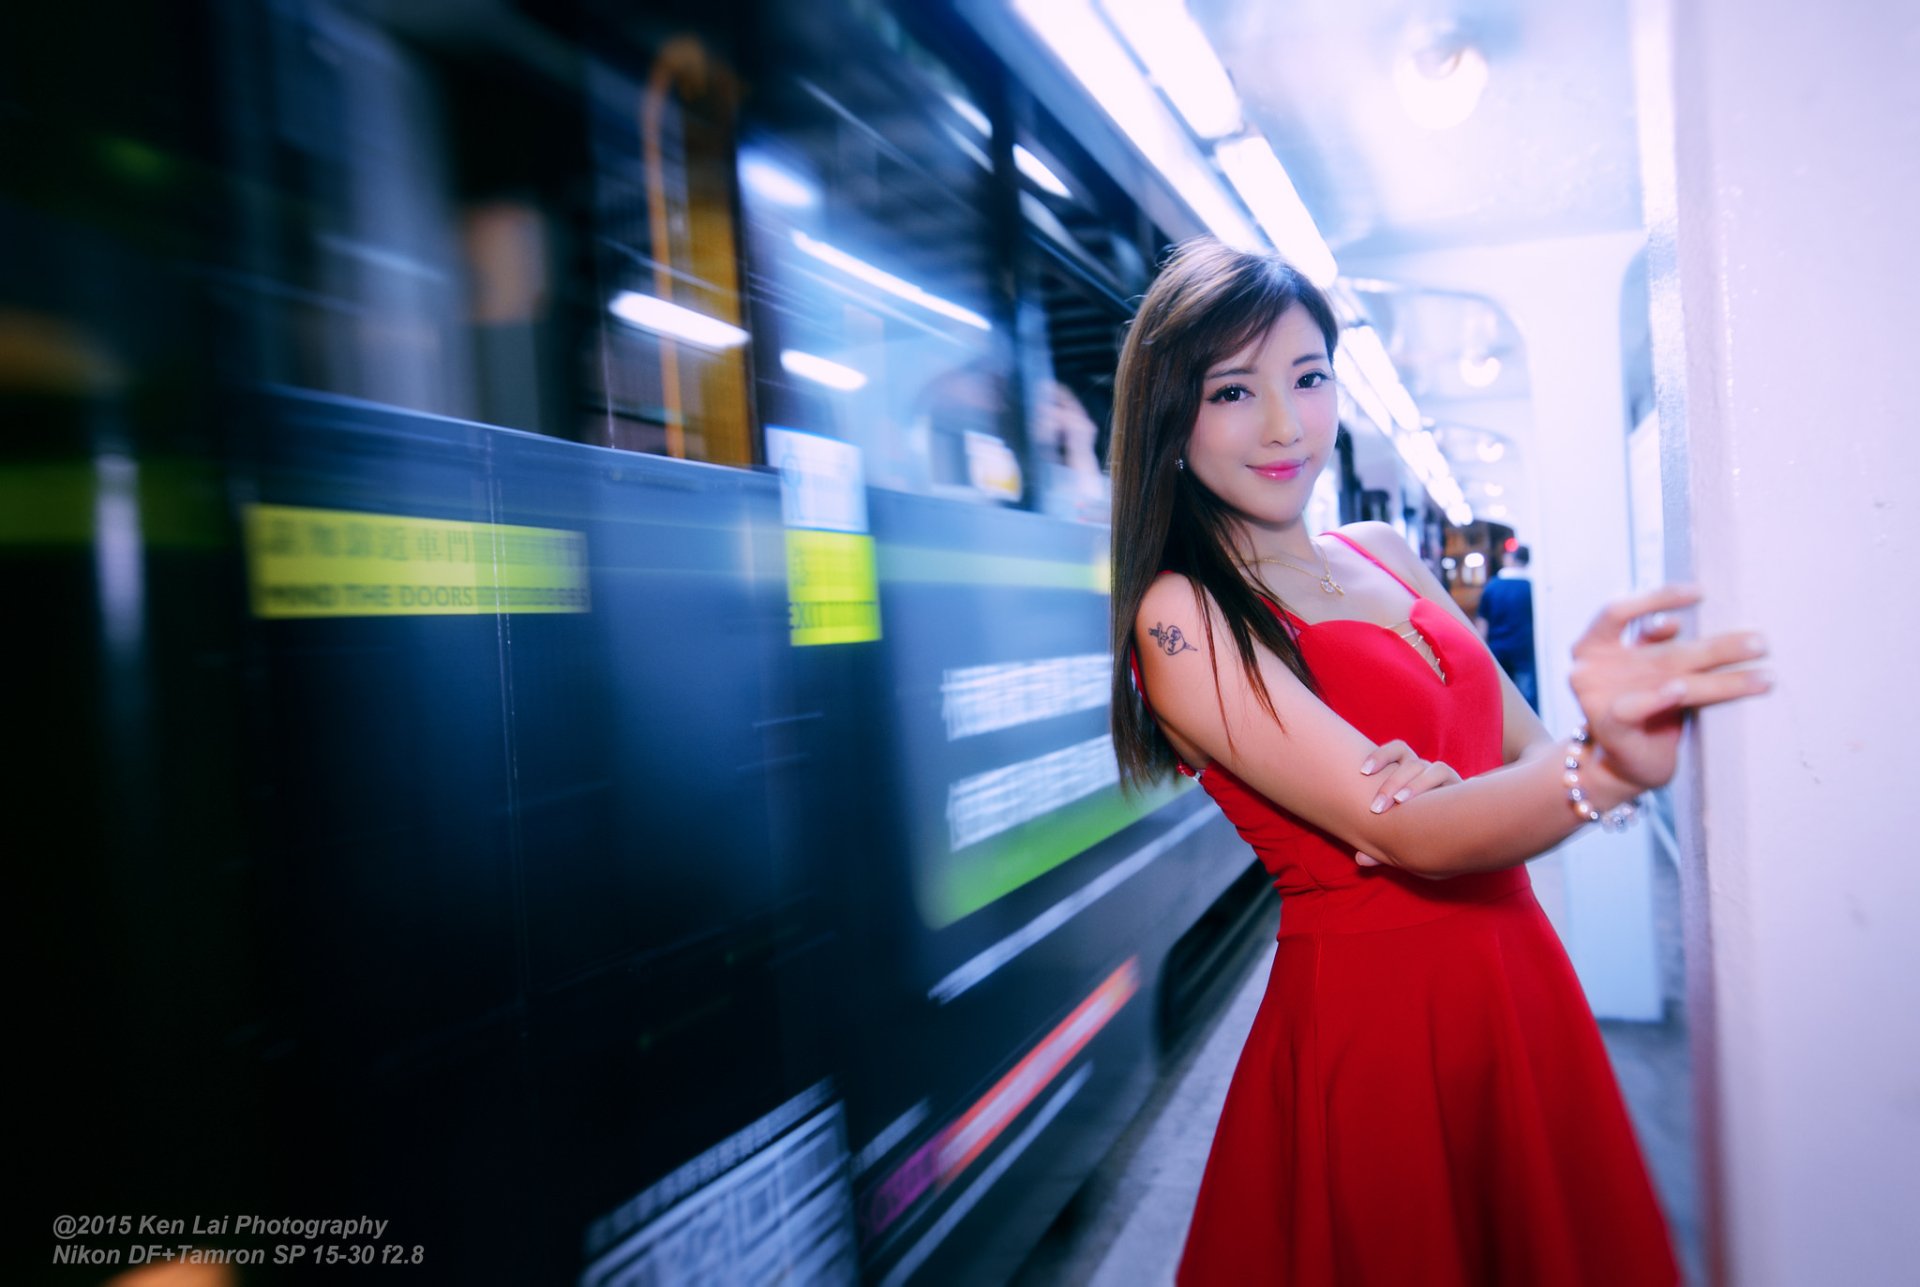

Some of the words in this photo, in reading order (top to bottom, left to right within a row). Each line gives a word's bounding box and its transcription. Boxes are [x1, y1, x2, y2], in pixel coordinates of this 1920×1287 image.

[268, 518, 470, 563] 近車門
[398, 584, 474, 607] DOORS
